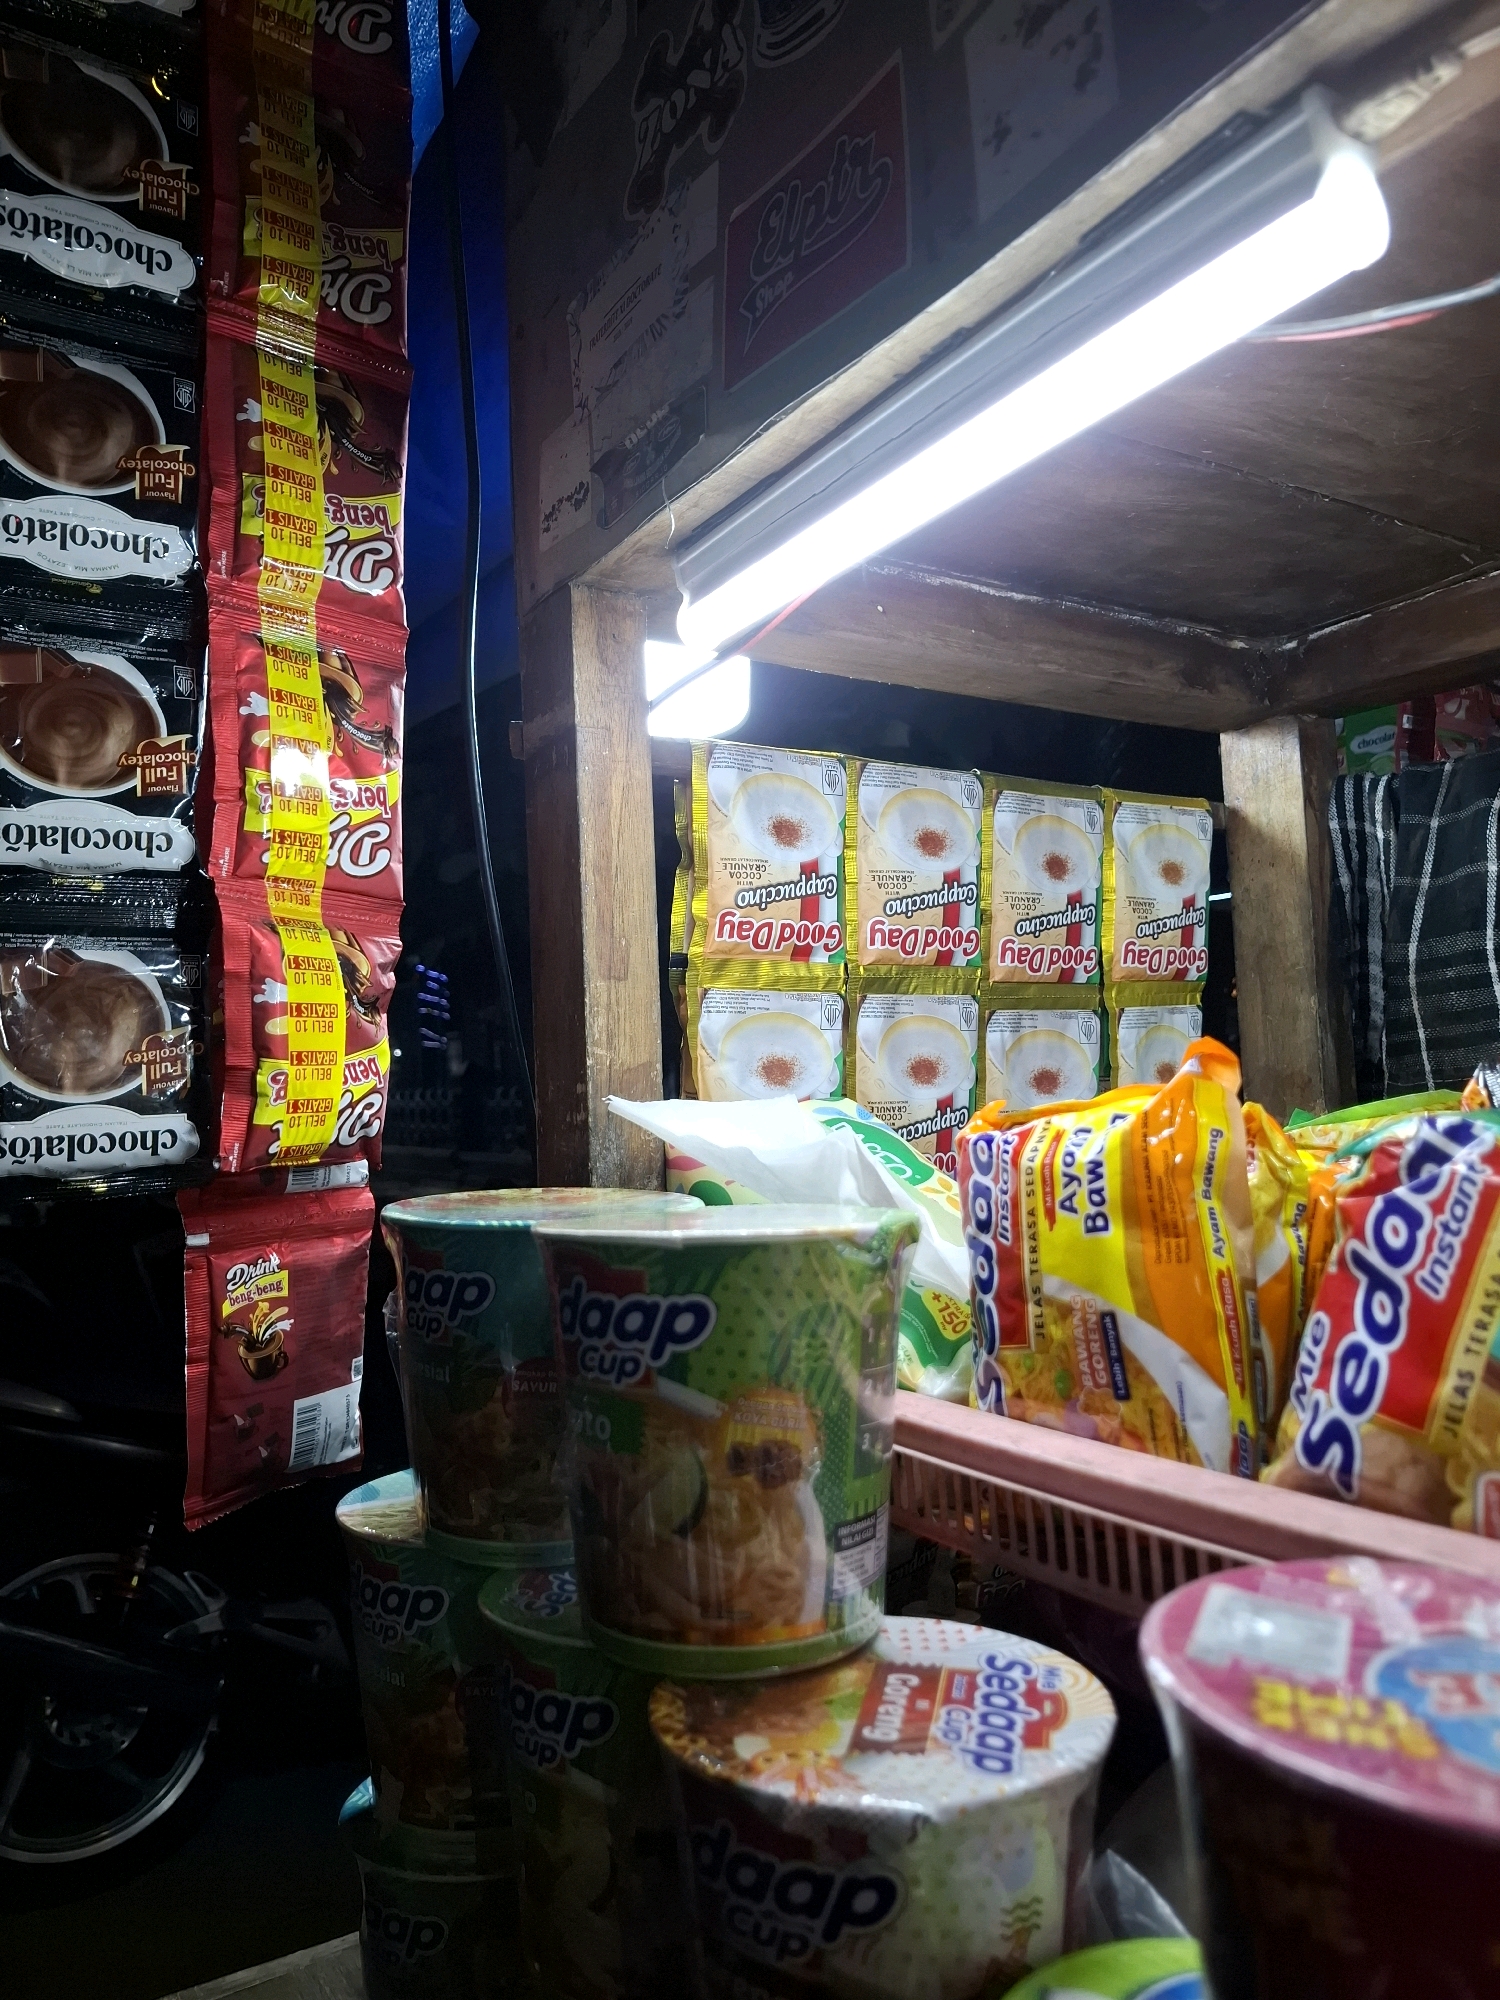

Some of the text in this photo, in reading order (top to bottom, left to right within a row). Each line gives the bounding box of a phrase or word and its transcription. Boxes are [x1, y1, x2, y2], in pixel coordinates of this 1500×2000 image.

[122, 167, 200, 195] Chocolatey
[147, 185, 178, 205] Full
[149, 203, 178, 216] Flavour
[272, 383, 307, 406] GRATIS
[267, 393, 304, 419] BELI 10
[117, 457, 195, 476] Chocolatey
[144, 472, 175, 488] Full
[278, 468, 315, 491] GRATIS
[145, 490, 176, 500] Flavour
[271, 481, 311, 503] BELI 10
[277, 511, 316, 533] GRATIS
[271, 527, 312, 548] BELI 10
[280, 690, 315, 712] GRATIS
[276, 705, 313, 724] BELI 10
[341, 720, 372, 742] chocolate
[119, 751, 197, 768] Chocolatey
[146, 765, 178, 783] Full
[147, 785, 179, 793] Flavour
[284, 831, 320, 847] GRATIS
[276, 847, 316, 863] BELI 10
[721, 862, 767, 871] GRANULE
[728, 870, 762, 879] COCOA
[870, 874, 913, 882] GRANULE
[877, 881, 908, 890] COCOA
[735, 873, 838, 909] Cappuccino
[884, 881, 977, 919] Cappuccino
[1004, 895, 1041, 903] GRANULE
[1010, 903, 1037, 911] COCOA
[1127, 899, 1155, 907] GRANULE
[1132, 907, 1152, 915] COCOA
[715, 908, 842, 953] Good Day
[1016, 904, 1096, 937] Cappuccino
[1136, 906, 1206, 939] Cappuccino
[866, 916, 980, 958] Good Day
[998, 936, 1097, 976] Good Day
[1121, 940, 1208, 976] Good Day
[124, 1042, 204, 1066] Chocolatey
[302, 1051, 337, 1065] GRATIS
[150, 1059, 183, 1080] Full
[295, 1067, 332, 1082] BELI 10
[300, 1098, 332, 1112] GRATIS
[289, 1114, 326, 1128] BELI 10
[1058, 1126, 1093, 1215] Ayam
[1201, 1128, 1223, 1201] Bawang
[998, 1133, 1019, 1245] Instant
[1045, 1165, 1053, 1195] Kuah
[1026, 1118, 1051, 1340] JELAS TERASA SEDAPNYA
[1208, 1204, 1225, 1258] Ayam
[226, 1252, 281, 1290] Drink
[227, 1277, 284, 1307] beng-beng
[1222, 1278, 1236, 1312] Rasa
[1070, 1295, 1093, 1387] BAWANG
[1084, 1298, 1107, 1384] GORENG
[1228, 1315, 1241, 1360] Kuah
[580, 1344, 641, 1385] Cup
[1103, 1315, 1126, 1395] Lebih Banyak
[1291, 1311, 1330, 1420] Mie
[1441, 1370, 1476, 1439] JELAS
[838, 1515, 876, 1537] INFORMASI
[841, 1526, 874, 1546] NILAI GIZI
[861, 1673, 920, 1741] Goreng
[959, 1651, 1039, 1776] Sedaap
